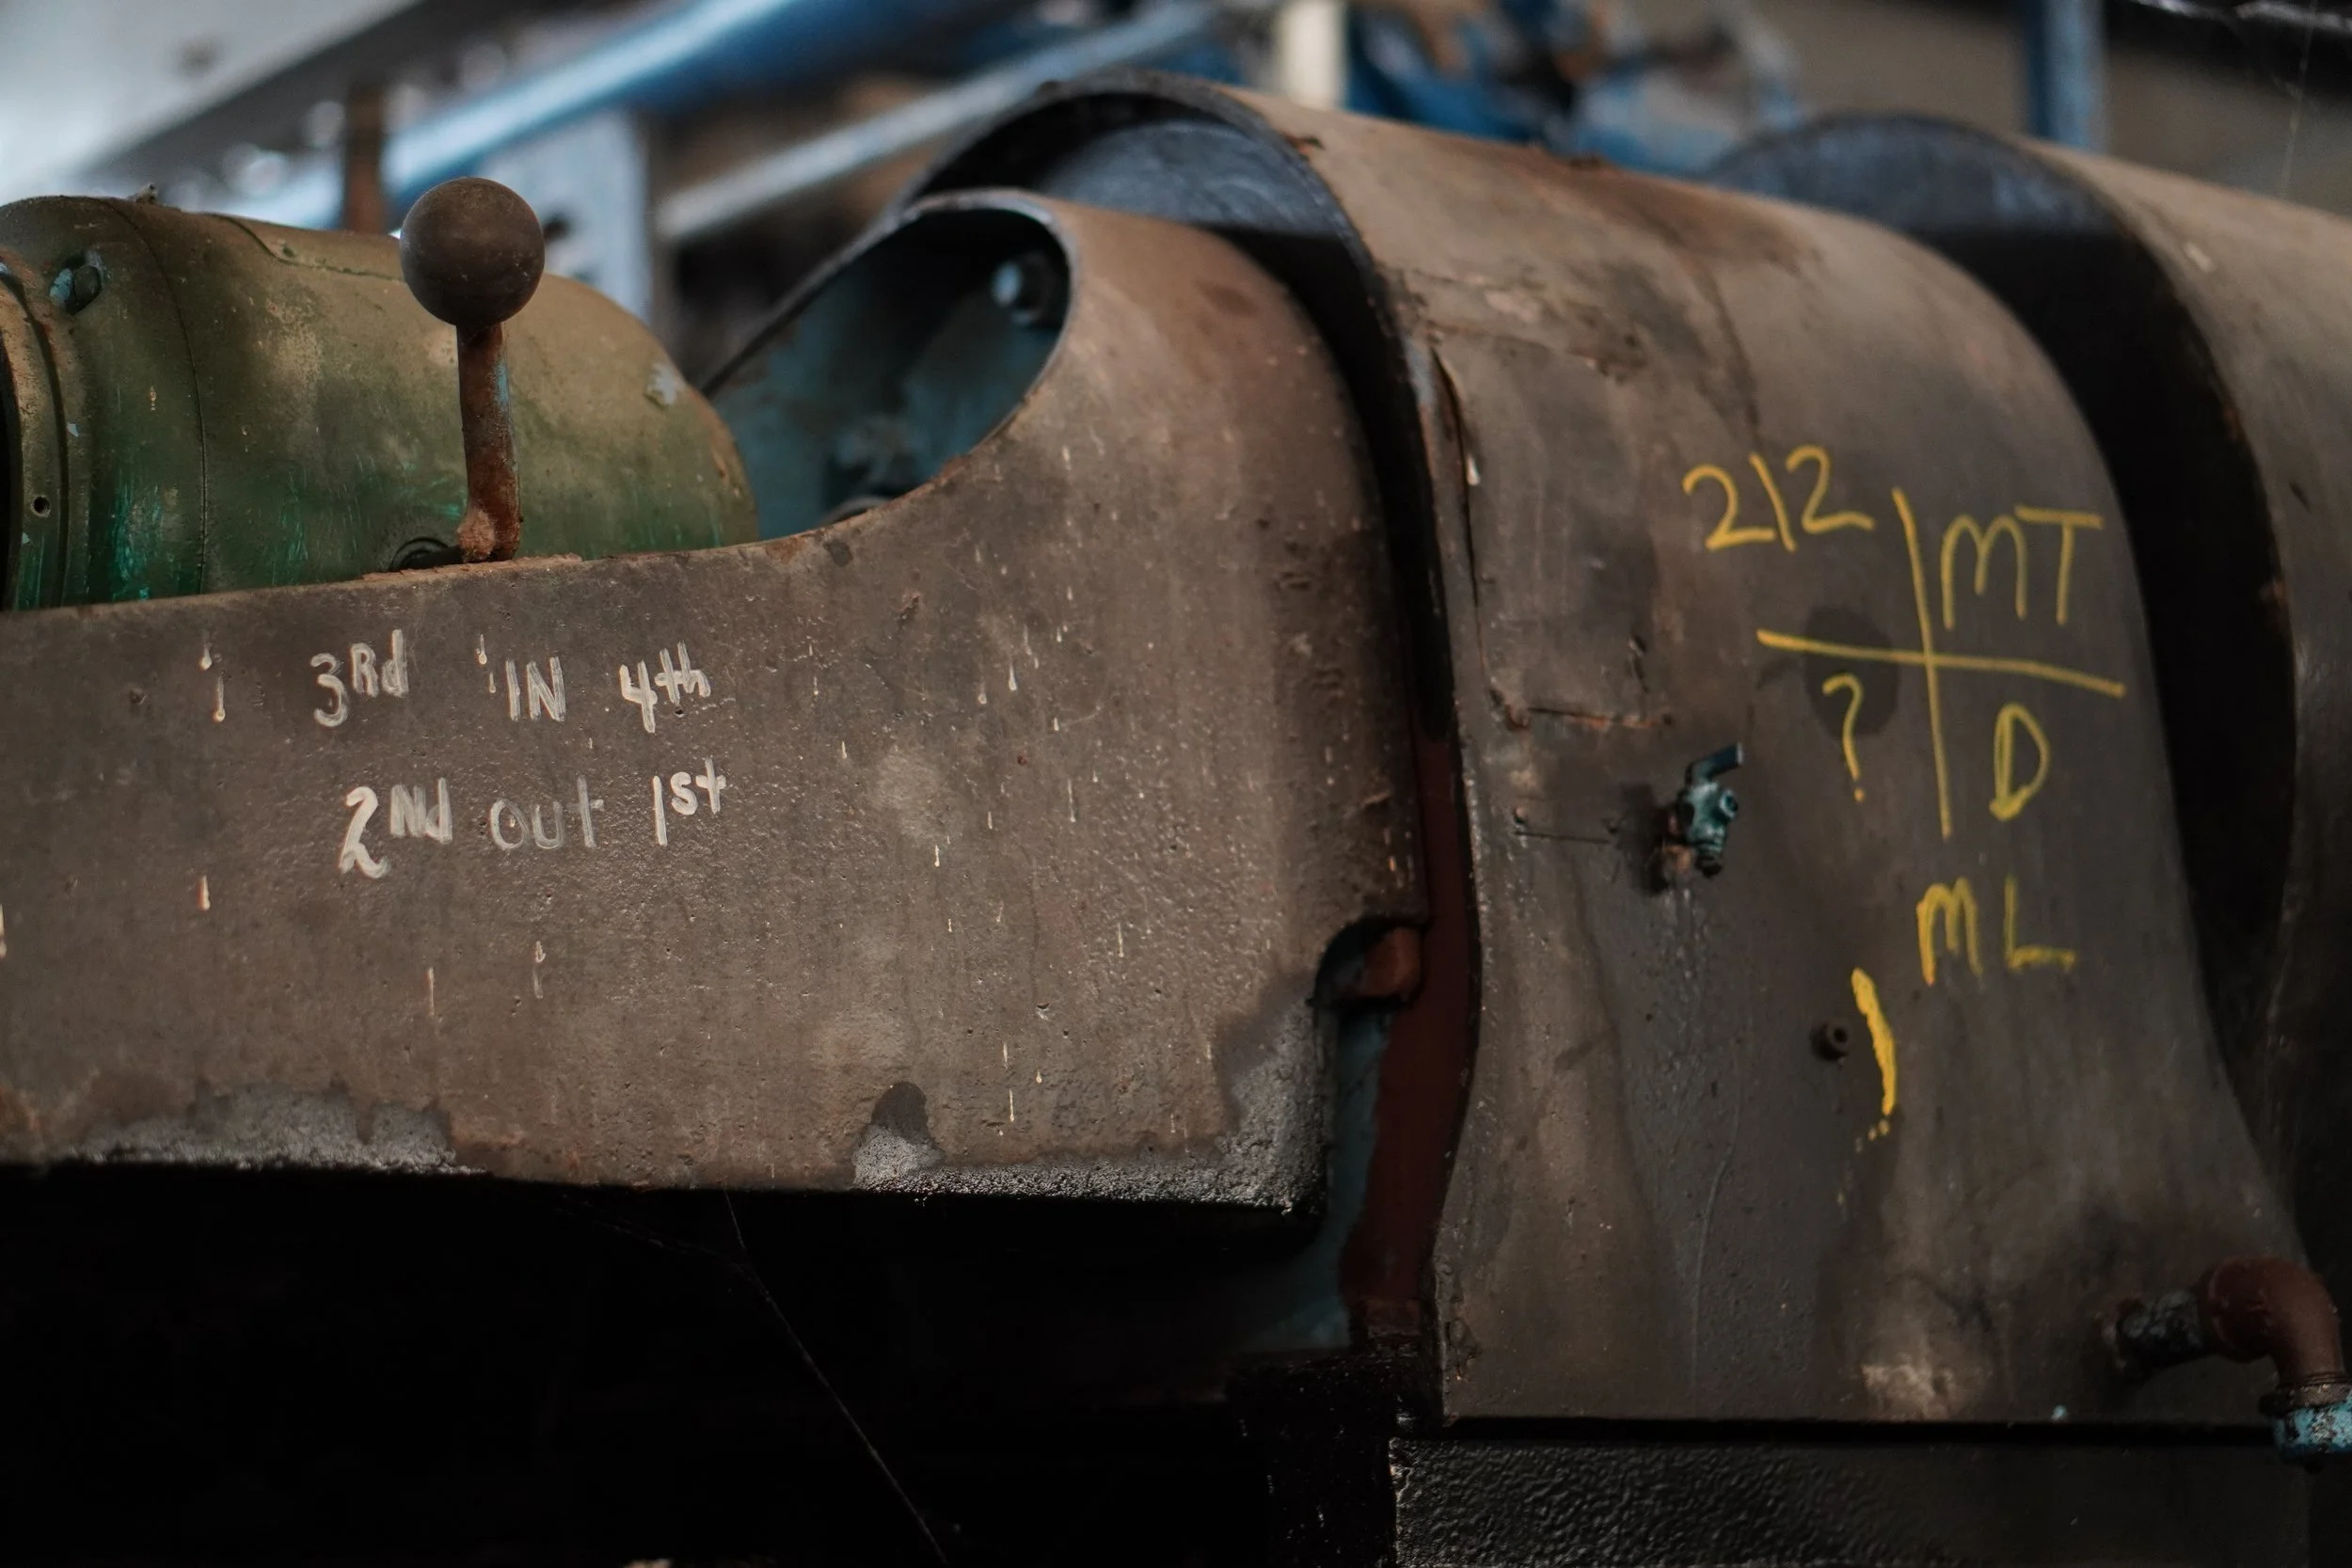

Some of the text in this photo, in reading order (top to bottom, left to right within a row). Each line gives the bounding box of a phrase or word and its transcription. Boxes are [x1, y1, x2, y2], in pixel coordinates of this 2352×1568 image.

[1683, 445, 1875, 552] 212
[505, 657, 565, 722] IN
[619, 641, 711, 734] 4th
[1822, 670, 1864, 803] ?
[1989, 704, 2051, 820] D
